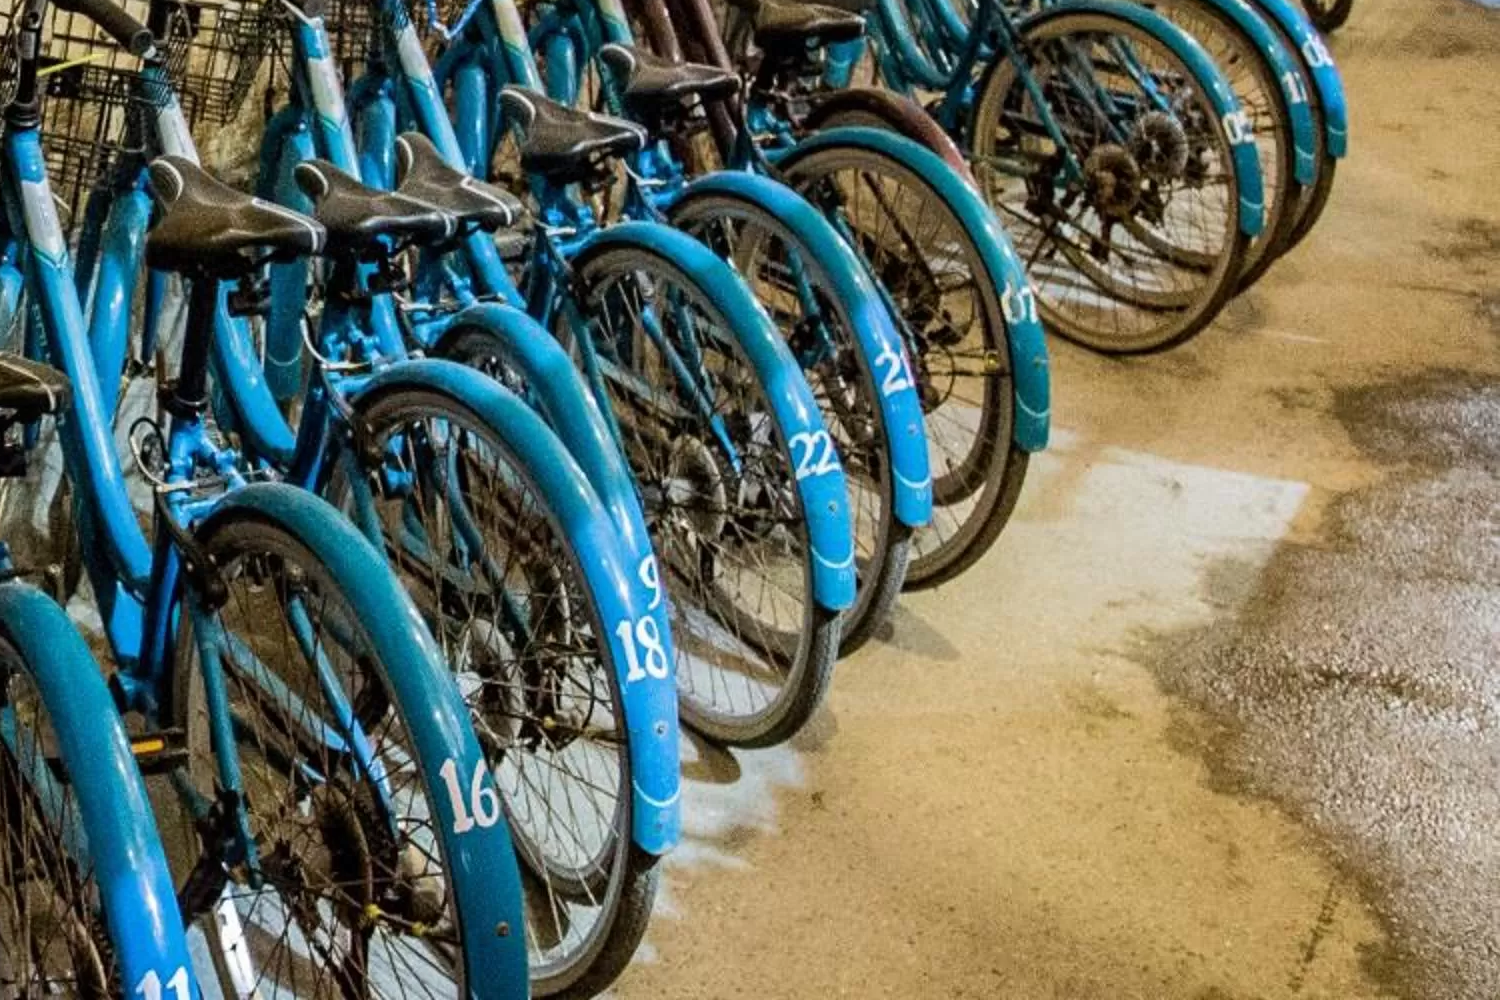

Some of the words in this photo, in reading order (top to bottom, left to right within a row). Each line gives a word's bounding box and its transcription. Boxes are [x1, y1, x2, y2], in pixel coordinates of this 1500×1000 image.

[788, 429, 842, 481] 22
[616, 615, 668, 682] 18
[439, 758, 500, 834] 16
